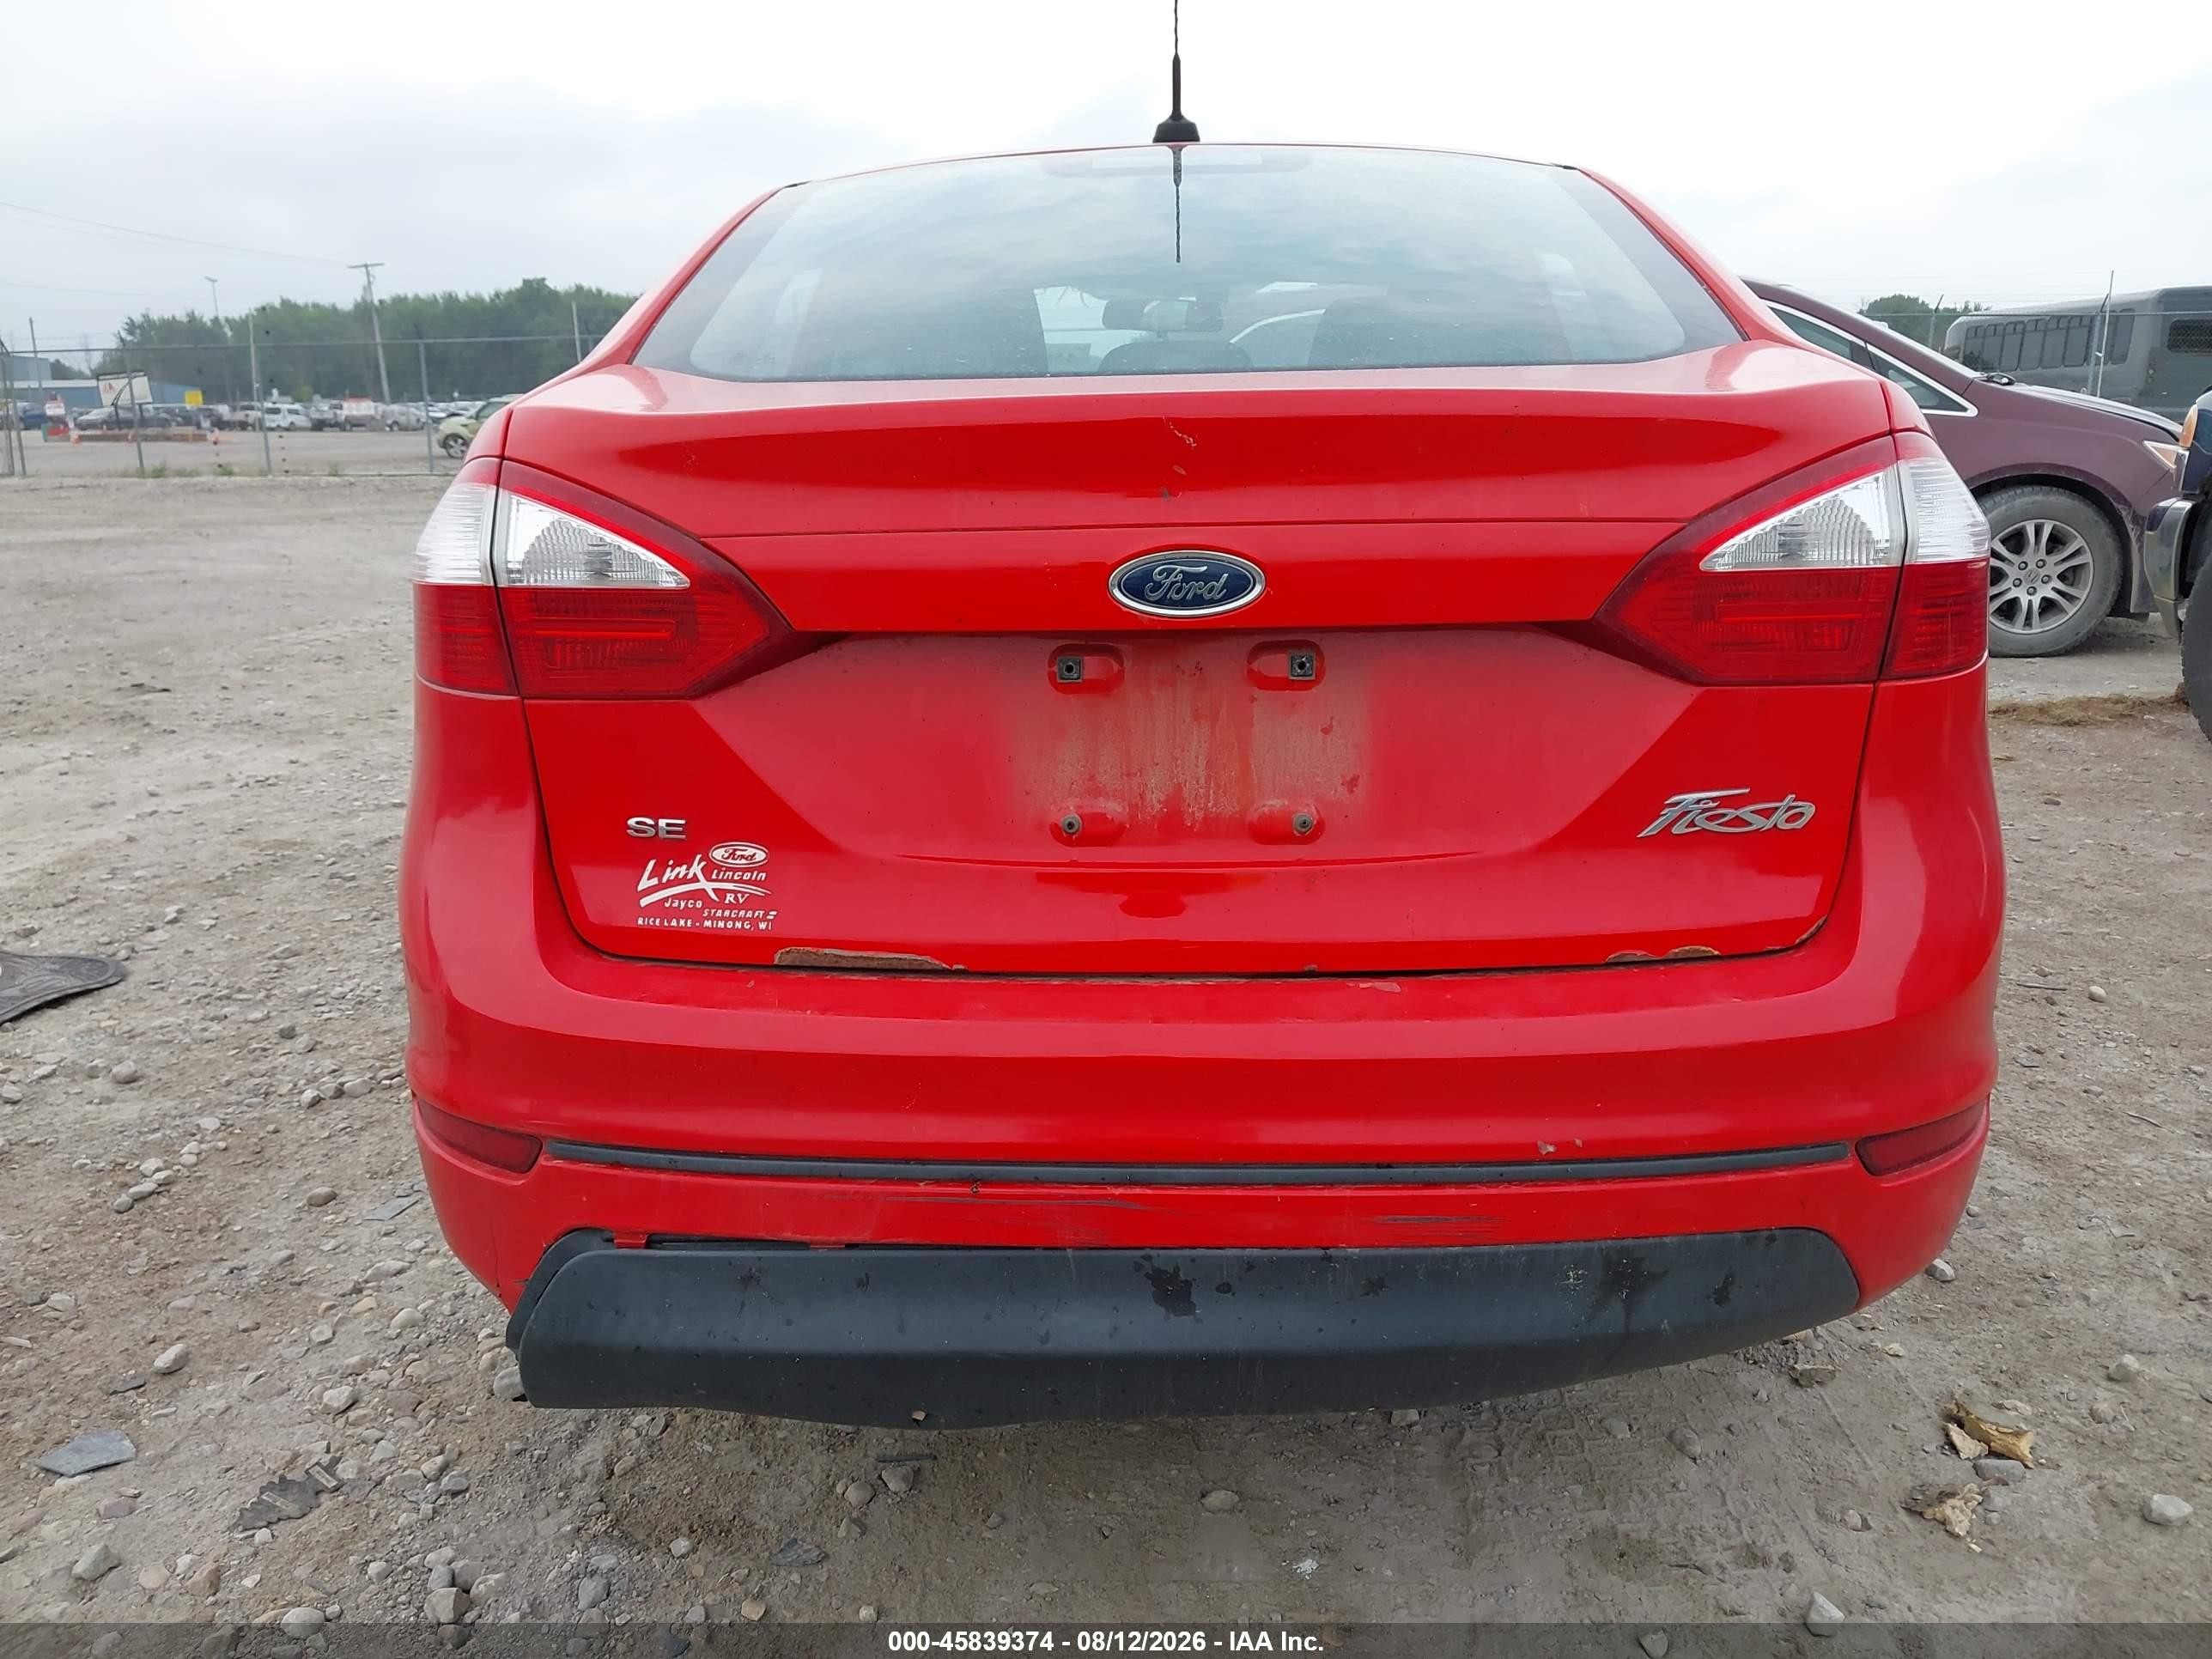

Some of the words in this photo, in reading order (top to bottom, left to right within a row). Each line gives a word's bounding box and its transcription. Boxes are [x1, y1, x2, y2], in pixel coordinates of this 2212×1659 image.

[1145, 565, 1229, 600] Ford
[1636, 787, 1816, 838] Fiesta
[626, 817, 686, 839] SE
[721, 848, 757, 861] Ford
[637, 854, 719, 902] Link
[711, 867, 767, 881] Lincoln
[664, 897, 702, 910] Jayco
[724, 892, 750, 904] RV
[702, 908, 765, 919] STARCRAFT
[637, 917, 660, 926] RICE
[664, 918, 693, 927] LAKE
[703, 920, 754, 931] MINONG,
[758, 921, 772, 931] WI
